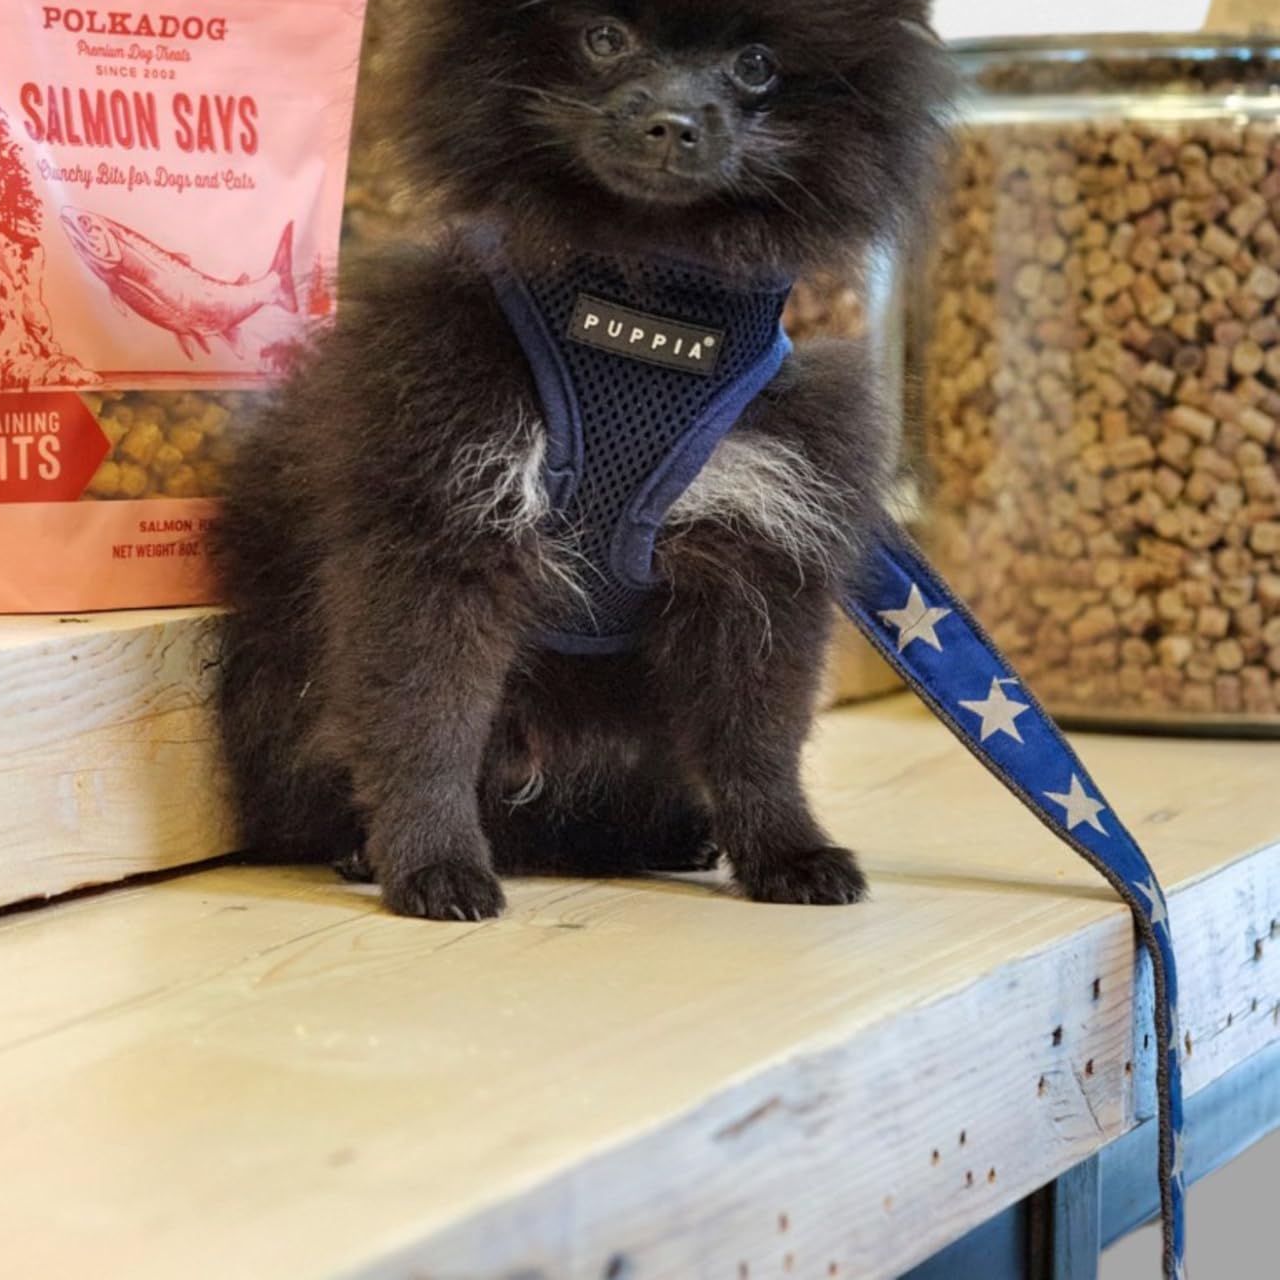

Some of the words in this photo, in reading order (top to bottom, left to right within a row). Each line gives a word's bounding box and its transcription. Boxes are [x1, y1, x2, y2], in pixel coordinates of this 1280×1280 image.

[42, 6, 229, 41] POLKADOG
[76, 38, 125, 59] Premium
[127, 42, 153, 64] Dog
[153, 43, 192, 63] Treats
[95, 65, 137, 78] SINCE
[143, 68, 177, 80] 2002
[19, 81, 160, 152] SALMON
[172, 91, 259, 156] SAYS
[95, 161, 126, 187] Bits
[127, 164, 151, 192] for
[154, 165, 192, 194] Dogs
[194, 169, 220, 190] and
[221, 168, 256, 191] Cats
[139, 519, 193, 533] SALMON
[112, 544, 133, 559] NET
[135, 542, 177, 558] WEIGHT
